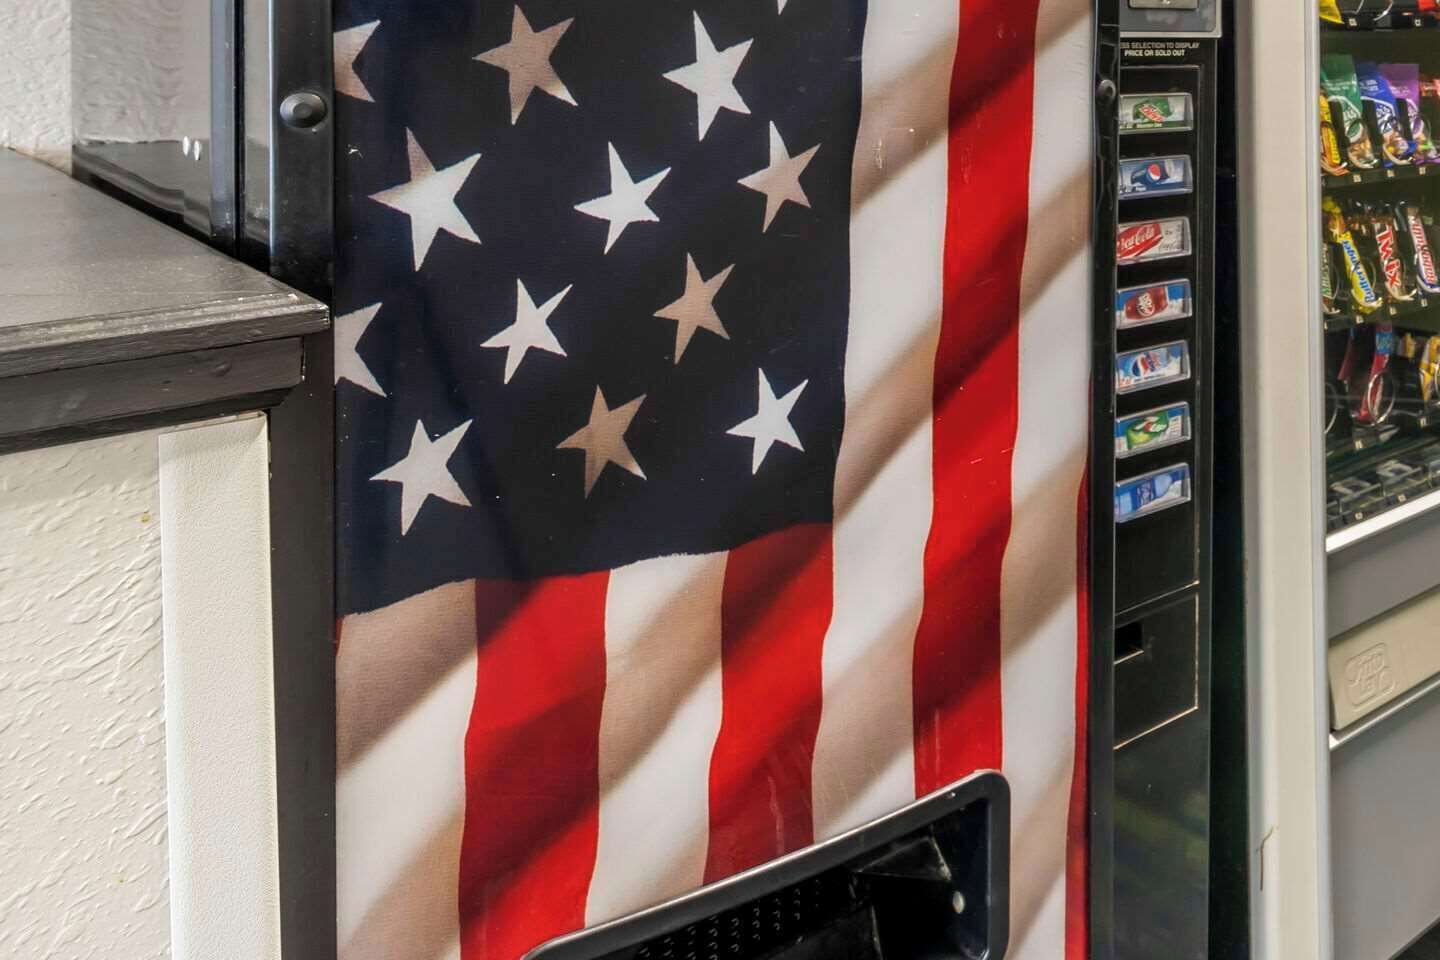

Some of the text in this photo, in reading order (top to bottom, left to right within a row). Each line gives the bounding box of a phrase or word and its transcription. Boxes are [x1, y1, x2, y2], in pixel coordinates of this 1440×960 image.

[1131, 41, 1167, 49] SELECTION
[1174, 41, 1200, 49] DISPLAY
[1124, 49, 1185, 57] PRICE OR SOLD OUT
[1375, 224, 1402, 288] Twix
